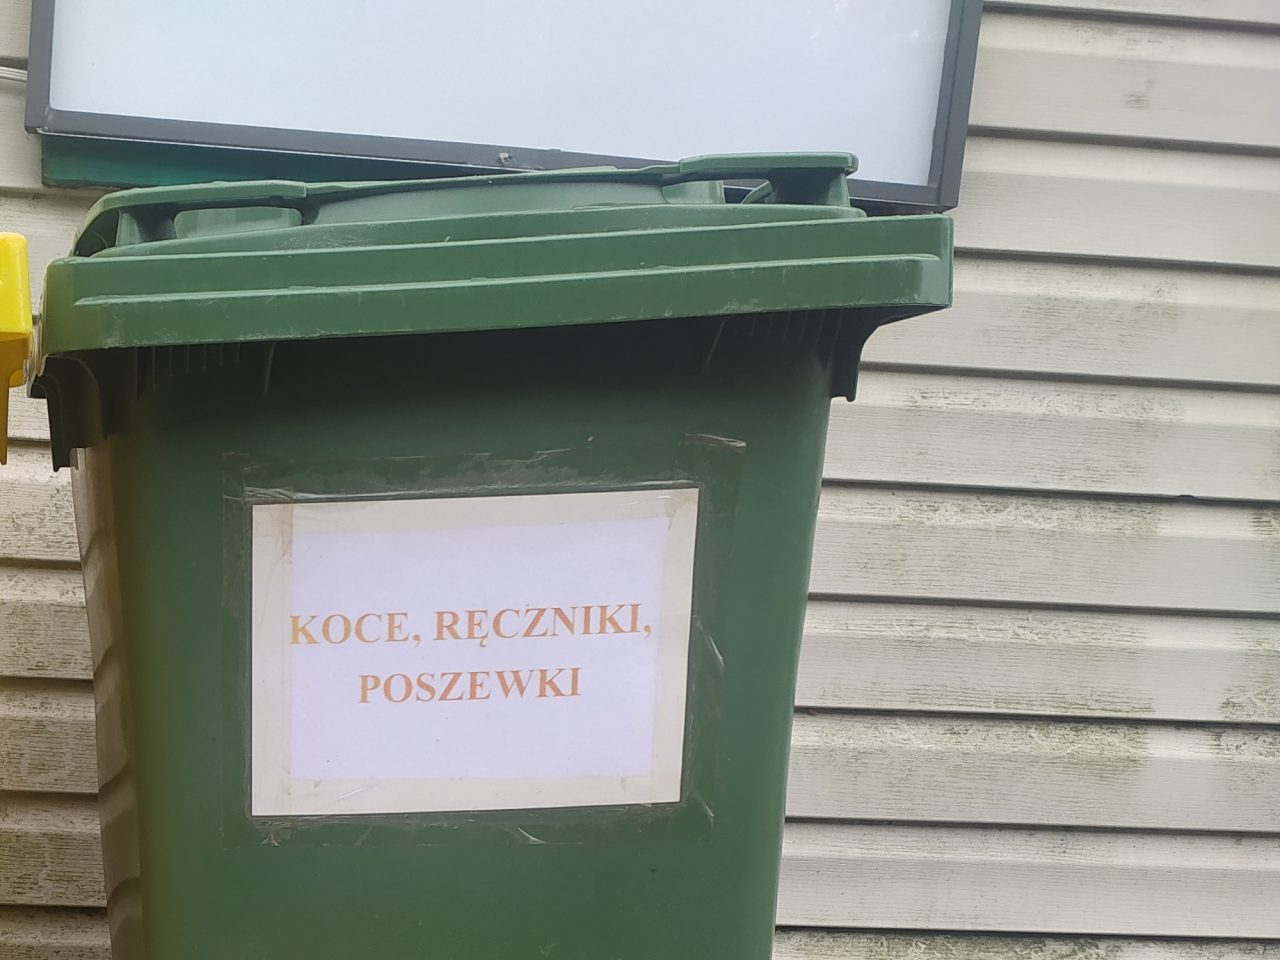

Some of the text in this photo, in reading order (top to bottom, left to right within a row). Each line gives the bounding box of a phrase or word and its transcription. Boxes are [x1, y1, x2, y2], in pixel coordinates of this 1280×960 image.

[289, 602, 652, 648] KOCE, RĘCZNIKI,
[358, 667, 582, 704] POSZEWKI
